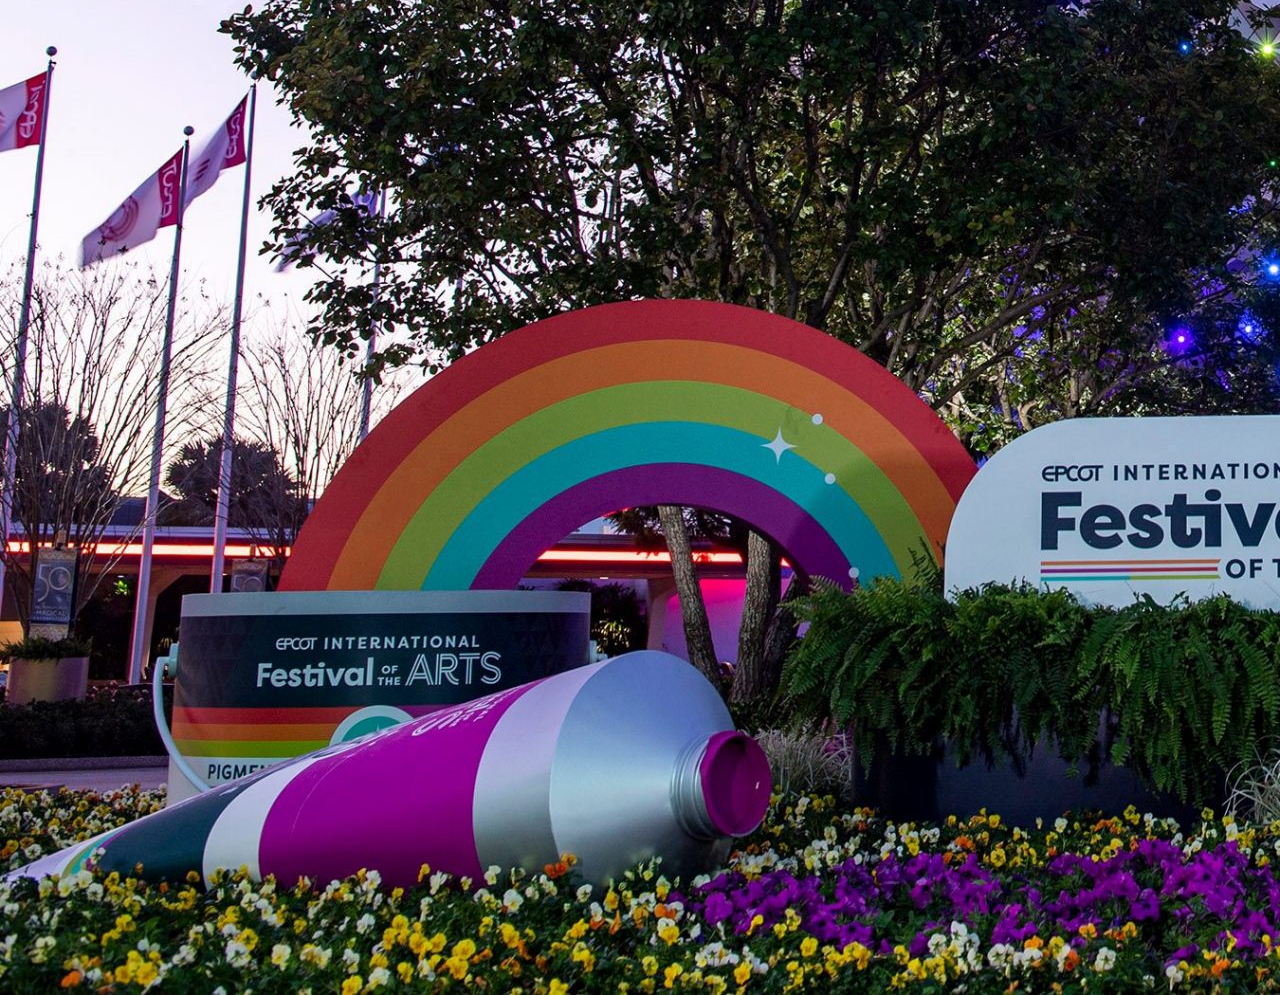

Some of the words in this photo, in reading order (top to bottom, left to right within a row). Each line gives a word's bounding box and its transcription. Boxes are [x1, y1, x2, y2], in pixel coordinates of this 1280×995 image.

[1041, 464, 1104, 482] EPCOT
[1225, 558, 1264, 579] OF
[275, 637, 318, 651] EPCOT
[324, 635, 481, 650] INTERNATIONAL
[256, 657, 375, 688] Festival
[381, 665, 399, 675] OF
[405, 651, 502, 686] ARTS
[377, 676, 401, 686] THE
